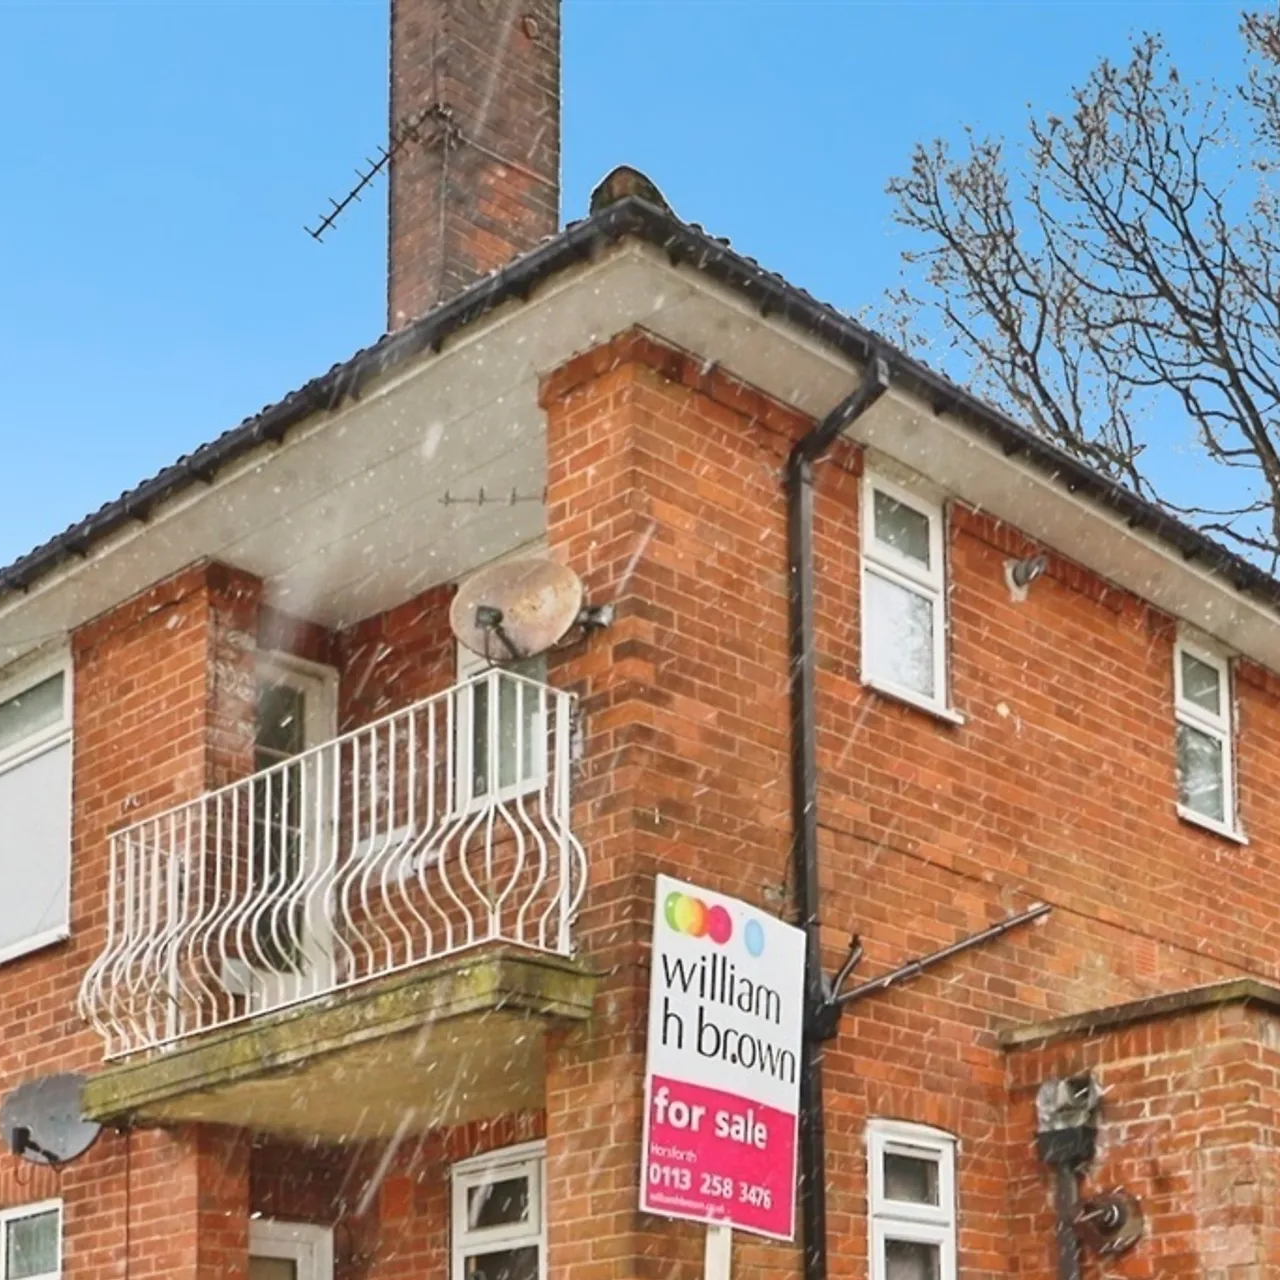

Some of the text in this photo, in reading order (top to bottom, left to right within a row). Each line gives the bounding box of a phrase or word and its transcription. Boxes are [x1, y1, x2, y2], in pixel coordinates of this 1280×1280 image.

[662, 953, 780, 1024] william
[662, 996, 796, 1084] h brown
[654, 1086, 767, 1149] for sale
[649, 1162, 692, 1191] 0113
[699, 1172, 734, 1199] 258
[738, 1181, 772, 1210] 3476
